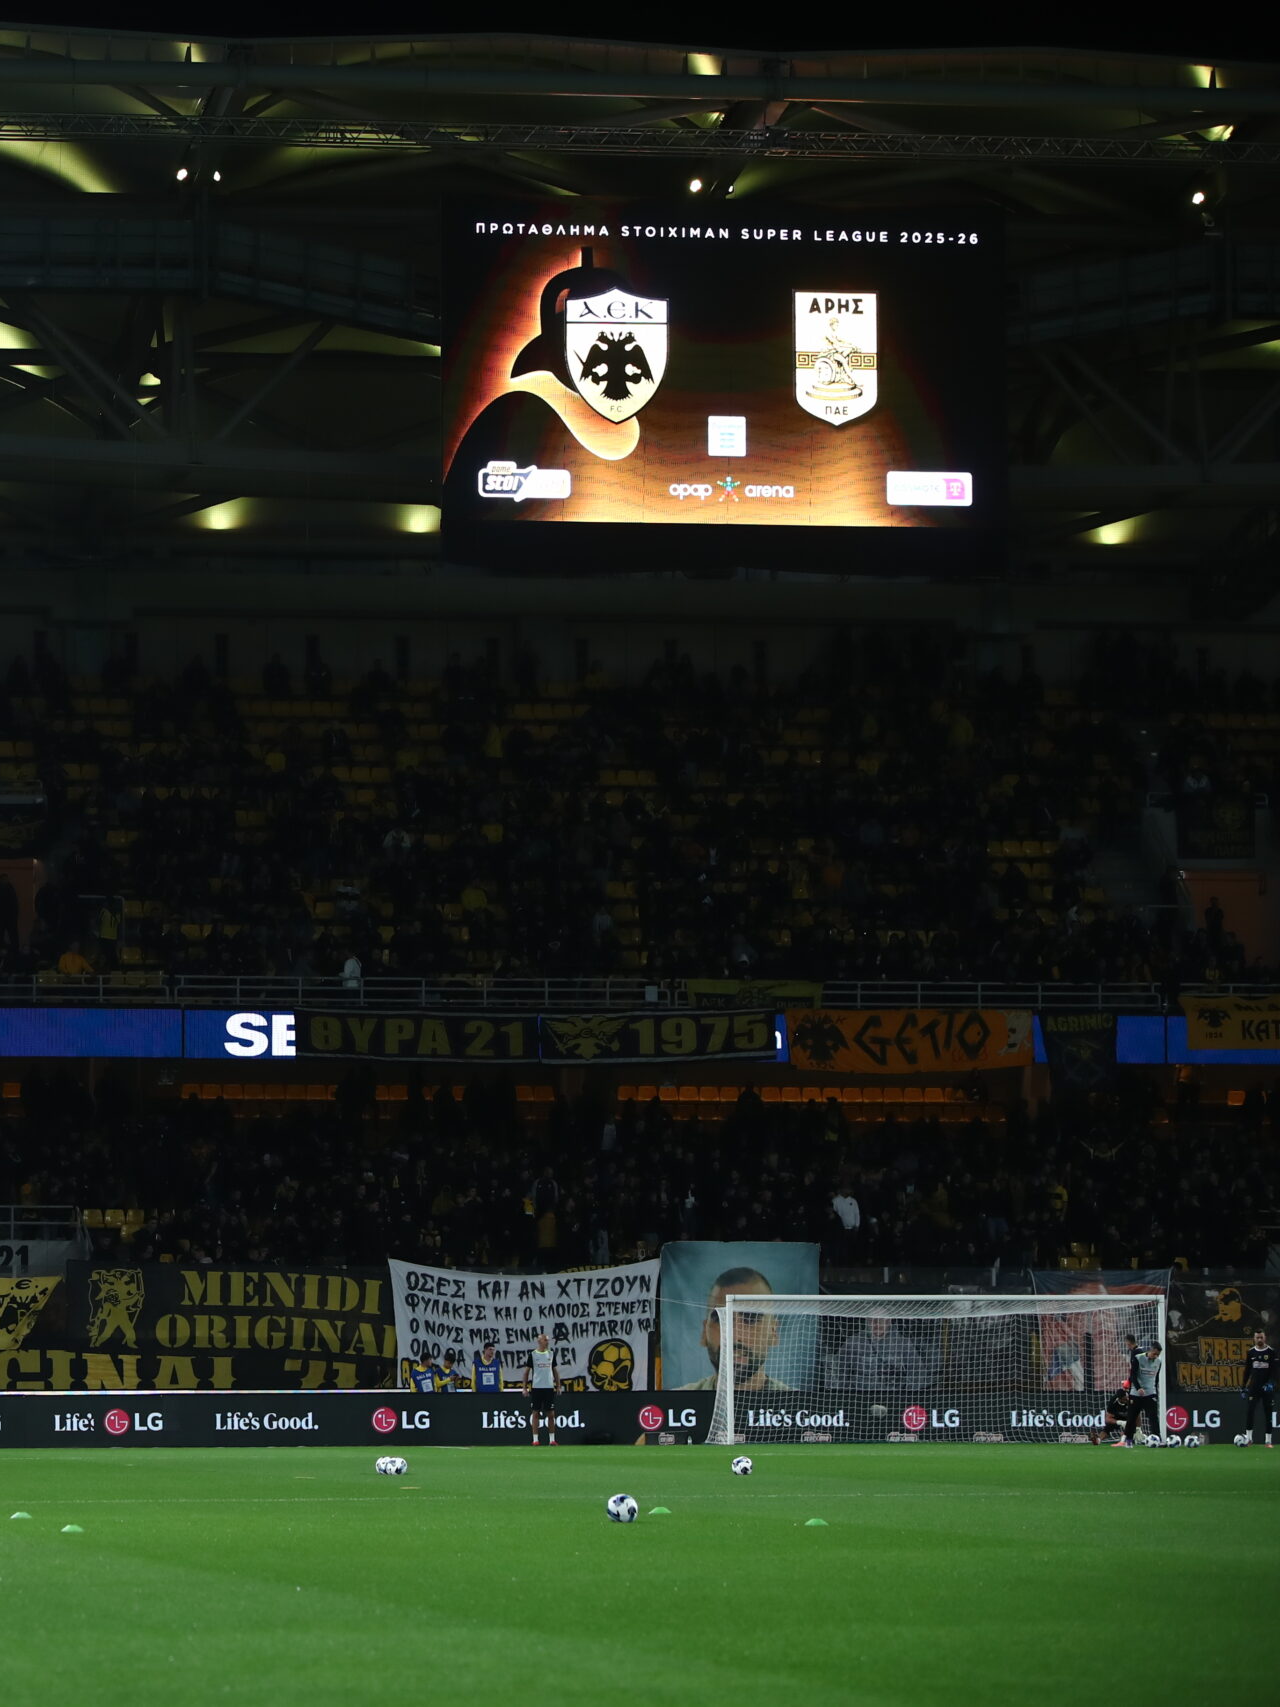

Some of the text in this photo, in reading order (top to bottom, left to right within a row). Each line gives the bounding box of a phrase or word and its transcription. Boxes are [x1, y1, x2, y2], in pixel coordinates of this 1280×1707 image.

[476, 222, 979, 245] ΠΡΩΤΑΘΛΗΜΑ STOIXIMAN SUPER LEAGUE 2025-26
[809, 297, 864, 316] ΑΡΗΣ
[824, 405, 849, 417] ΠΑΕ
[669, 483, 794, 500] opap arena
[464, 1022, 525, 1058] 21
[629, 1013, 769, 1056] 1975
[180, 1269, 383, 1315] MENIDI
[477, 1279, 510, 1301] ΚΑΙ
[517, 1279, 546, 1301] ΑΝ
[557, 1275, 652, 1300] ΧΤΙΖΟΥΝ
[405, 1293, 487, 1321] ΦΥΛΑΚΕΣ
[424, 1320, 464, 1344] ΝΟΥΣ
[469, 1328, 501, 1345] ΜΑΣ
[134, 1412, 163, 1432] LG
[263, 1411, 319, 1431] Good.
[401, 1410, 430, 1430] LG
[668, 1408, 697, 1428] LG
[795, 1409, 850, 1428] Good.
[932, 1409, 960, 1428] LG
[1192, 1409, 1221, 1428] LG
